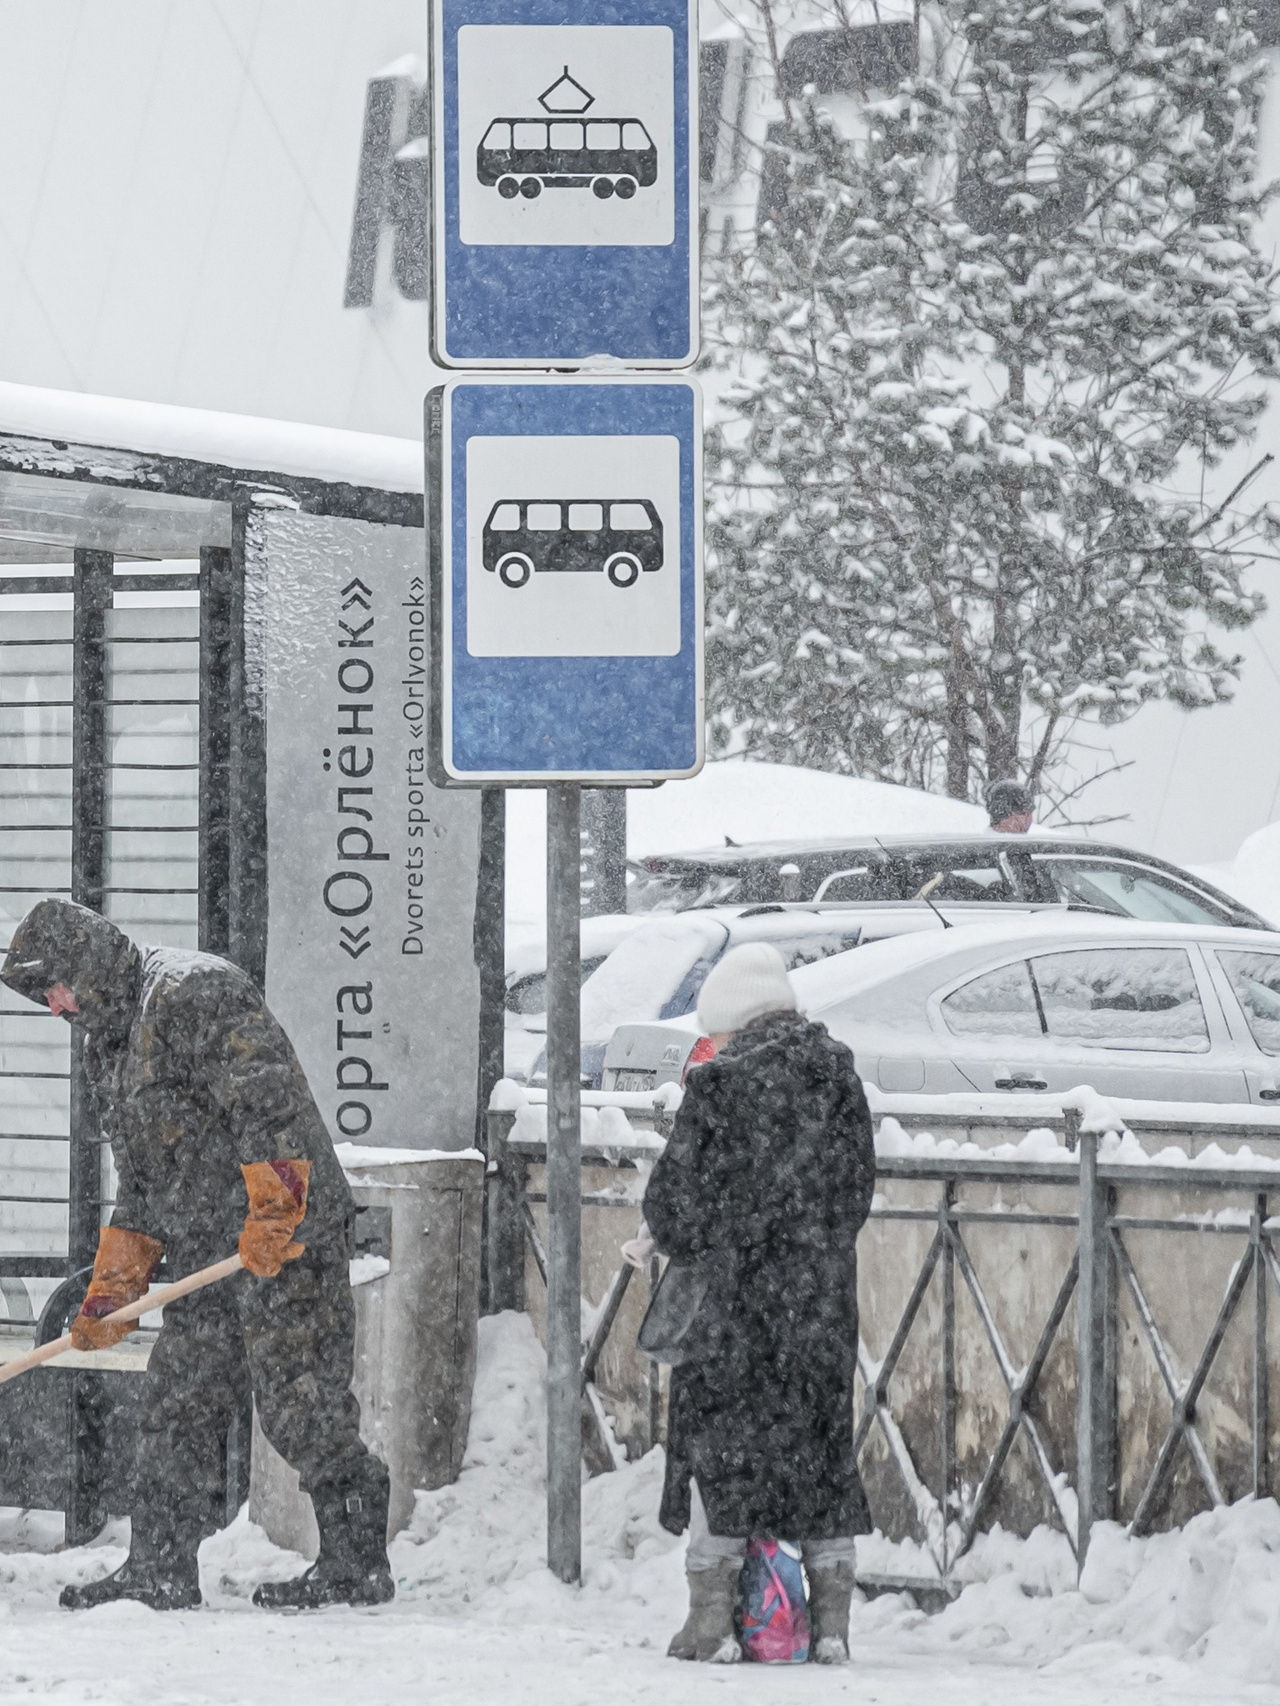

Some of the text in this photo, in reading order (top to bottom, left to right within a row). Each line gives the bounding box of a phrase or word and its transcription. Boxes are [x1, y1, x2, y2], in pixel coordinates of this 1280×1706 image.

[405, 746, 431, 838] sporta
[322, 576, 391, 1137] орта «Орлёнок»
[401, 846, 424, 955] Dvorets
